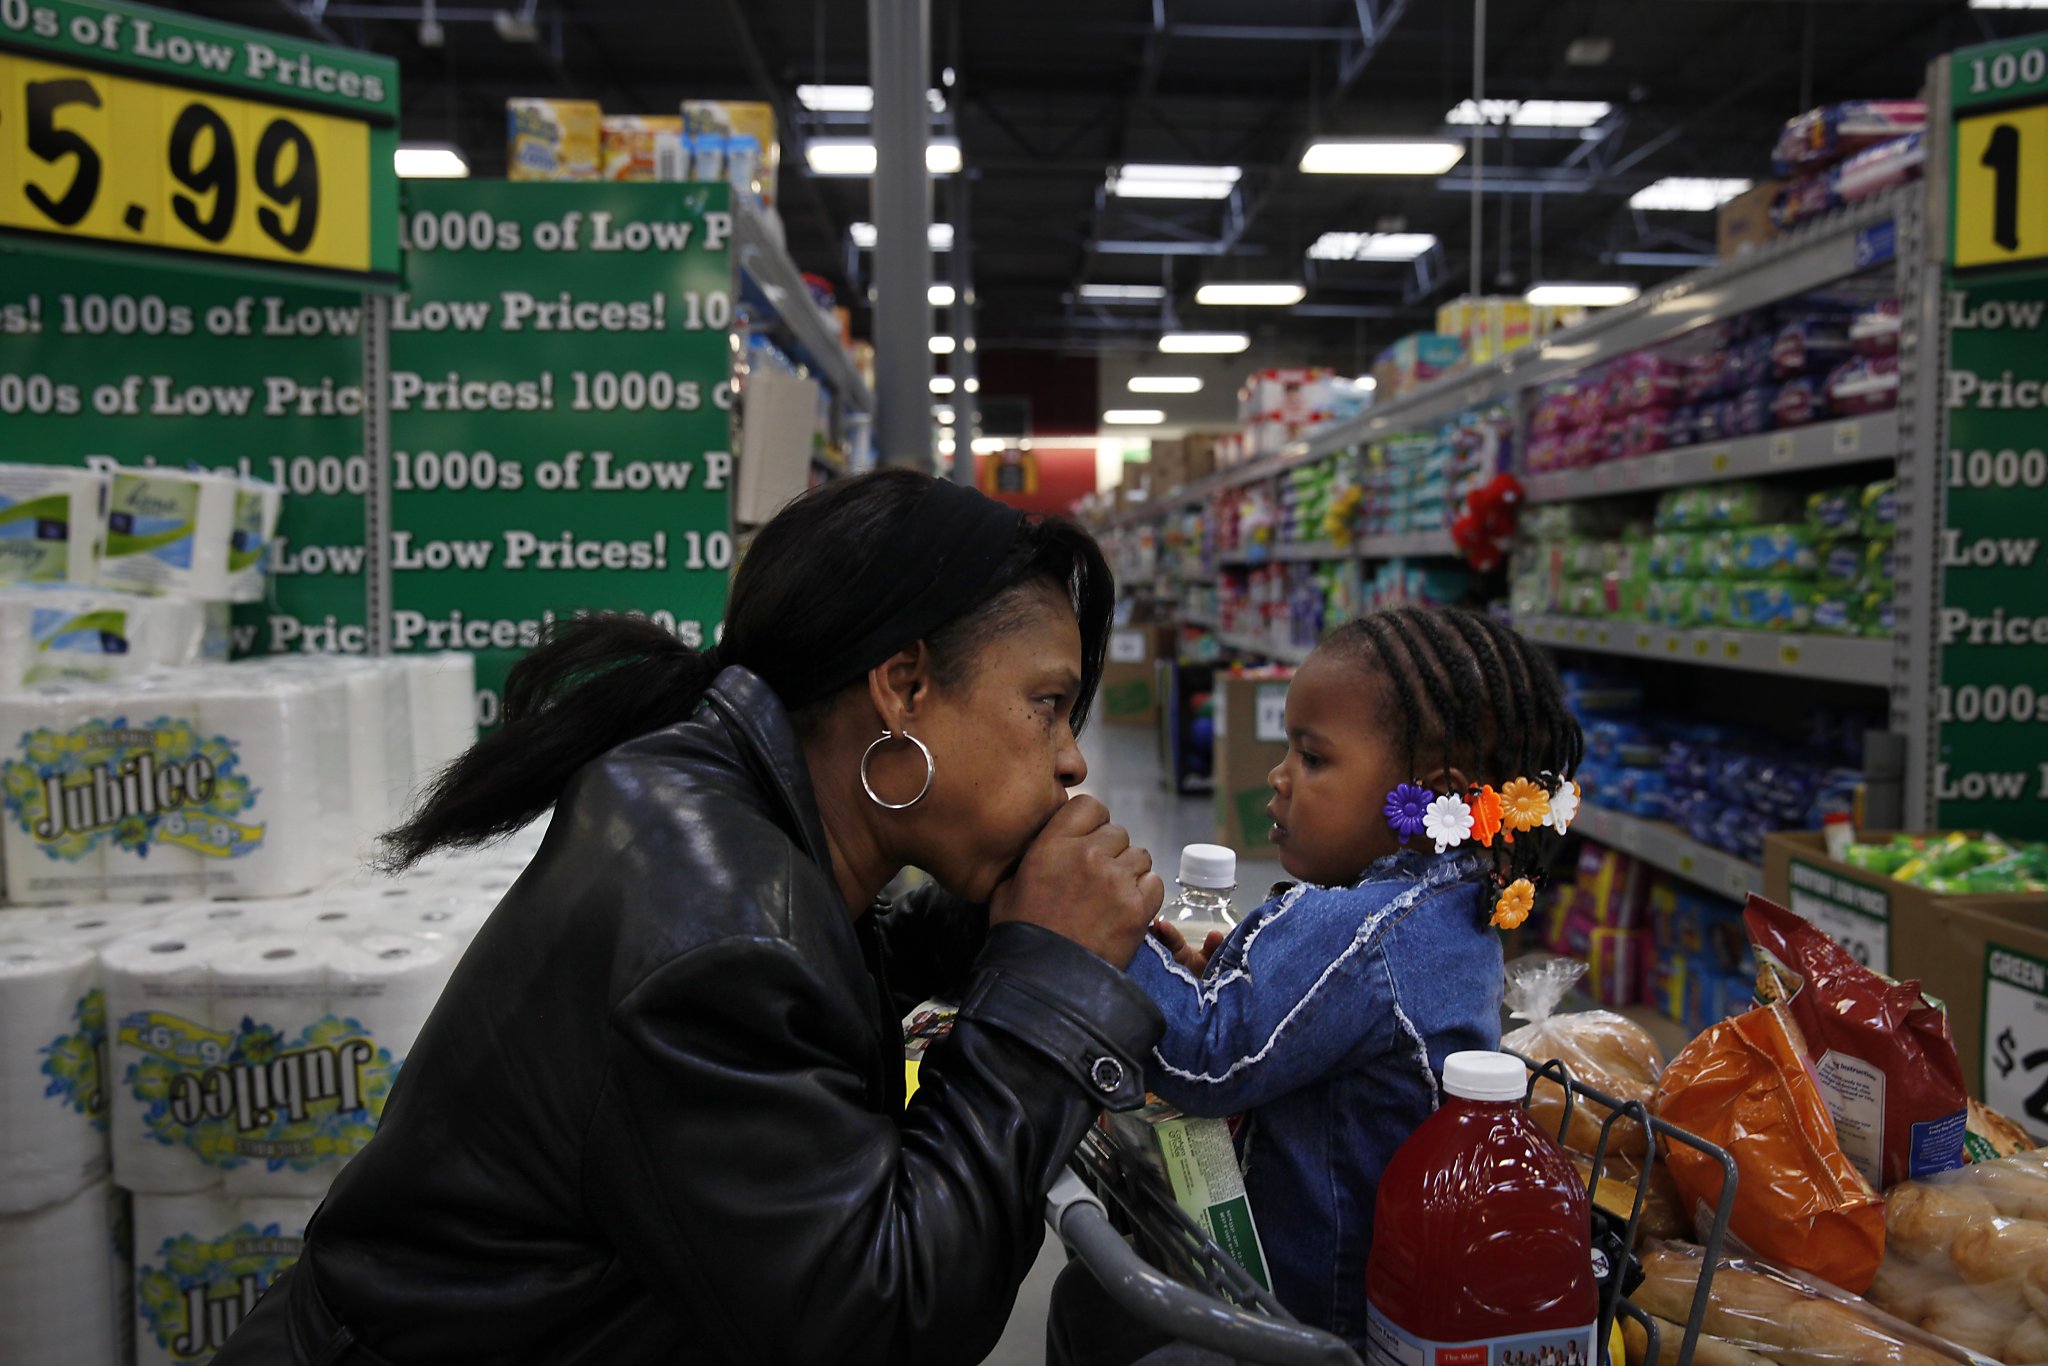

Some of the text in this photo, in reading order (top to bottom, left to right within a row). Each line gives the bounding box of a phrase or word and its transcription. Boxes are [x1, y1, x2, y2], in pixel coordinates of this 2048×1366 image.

[71, 15, 121, 51] of
[133, 19, 235, 72] Low
[245, 41, 386, 102] Prices
[24, 79, 320, 254] 5.99
[533, 211, 583, 250] of
[589, 211, 692, 250] Low
[0, 293, 364, 336] s! 1000s of Low
[391, 293, 490, 331] Low
[500, 292, 666, 331] Prices!
[1949, 290, 2044, 329] Low
[93, 374, 145, 415] of
[151, 375, 254, 416] Low
[390, 372, 554, 410] Prices!
[571, 372, 701, 411] 1000s
[393, 451, 524, 490] 1000s
[535, 450, 584, 490] of
[591, 451, 692, 490] Low
[271, 536, 366, 575] Low
[391, 531, 492, 569] Low
[503, 530, 667, 569] Prices!
[1940, 528, 2038, 567] Low
[34, 751, 216, 841] Jubilee
[1934, 762, 2028, 801] Low
[1989, 950, 2046, 992] GREEN
[170, 1038, 374, 1133] Jubilee
